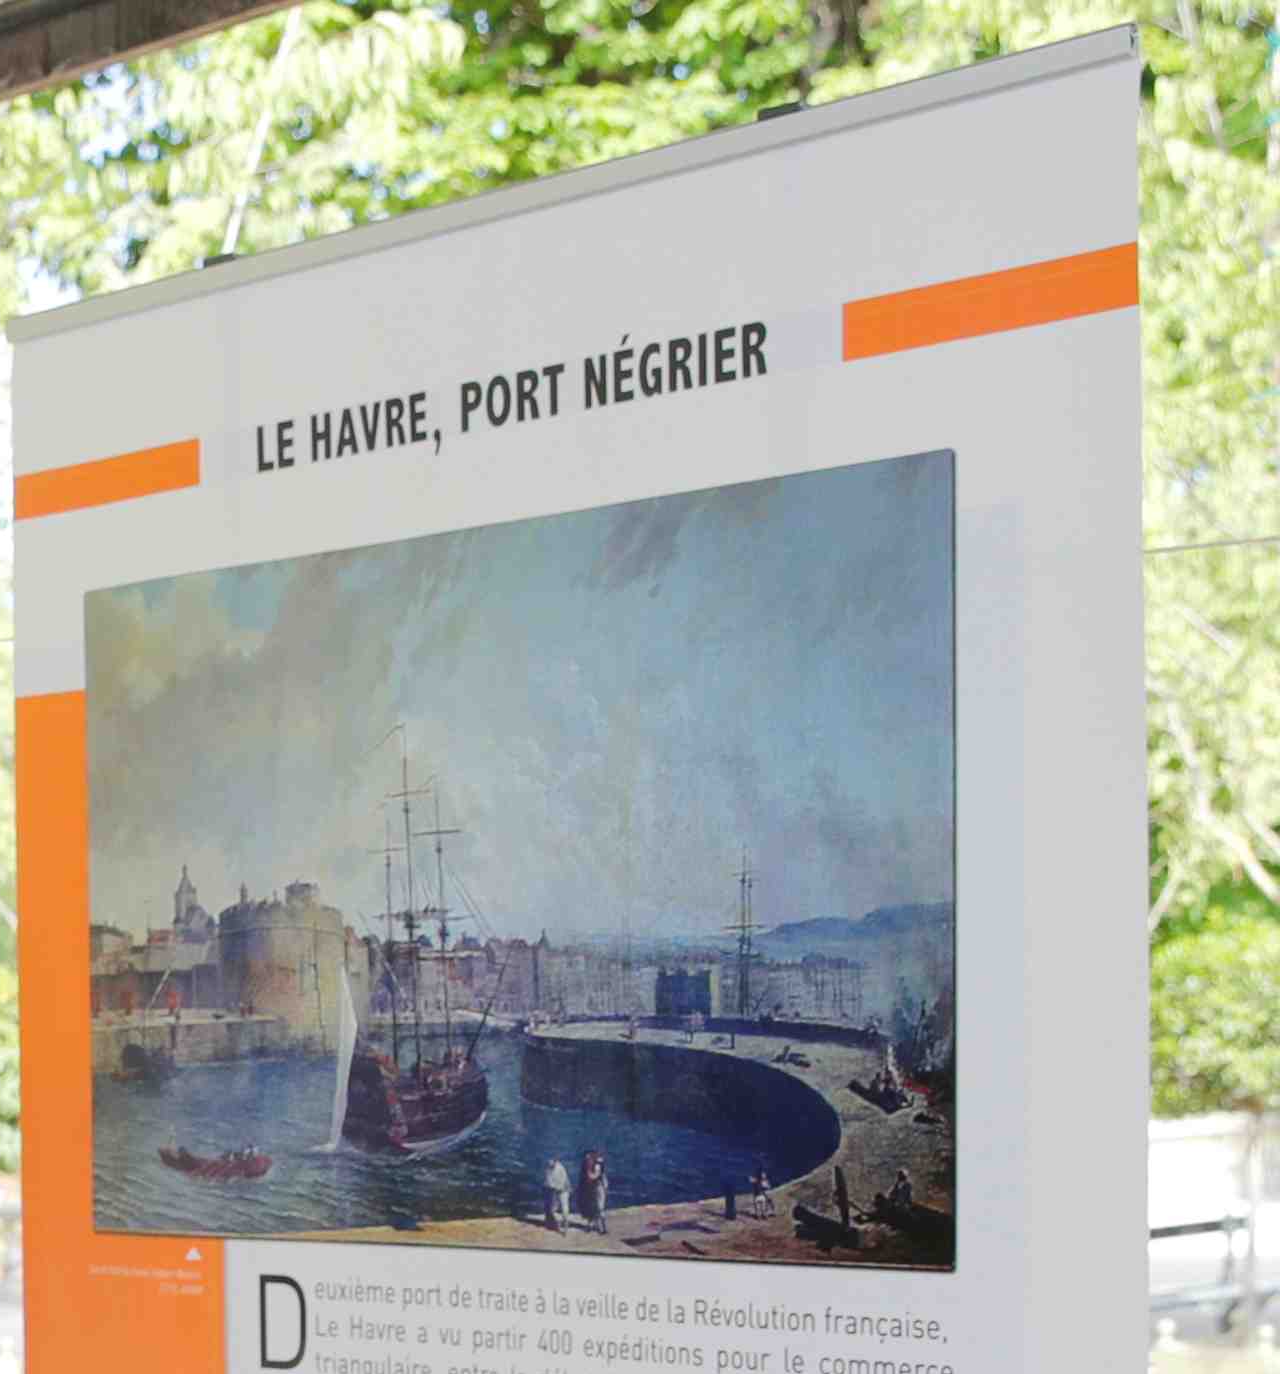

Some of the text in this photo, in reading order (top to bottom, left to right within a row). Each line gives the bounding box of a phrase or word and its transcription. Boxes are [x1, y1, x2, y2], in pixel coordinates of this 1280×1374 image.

[256, 321, 768, 473] LE HAVRE, PORT NÉGRIER
[400, 1281, 443, 1309] port
[447, 1280, 473, 1307] de
[476, 1284, 529, 1311] traite
[533, 1284, 547, 1312] à
[551, 1286, 571, 1314] la
[574, 1290, 629, 1318] veille
[634, 1292, 661, 1320] de
[665, 1294, 686, 1322] la
[692, 1295, 816, 1331] Révolution
[825, 1303, 948, 1341] française,
[315, 1311, 340, 1337] Le
[348, 1313, 408, 1341] Havre
[415, 1323, 429, 1342] a
[437, 1324, 463, 1345] vu
[470, 1325, 528, 1353] partir
[535, 1325, 574, 1354] 400
[581, 1331, 705, 1365] expéditions
[715, 1346, 770, 1374] pour
[782, 1344, 805, 1373] le
